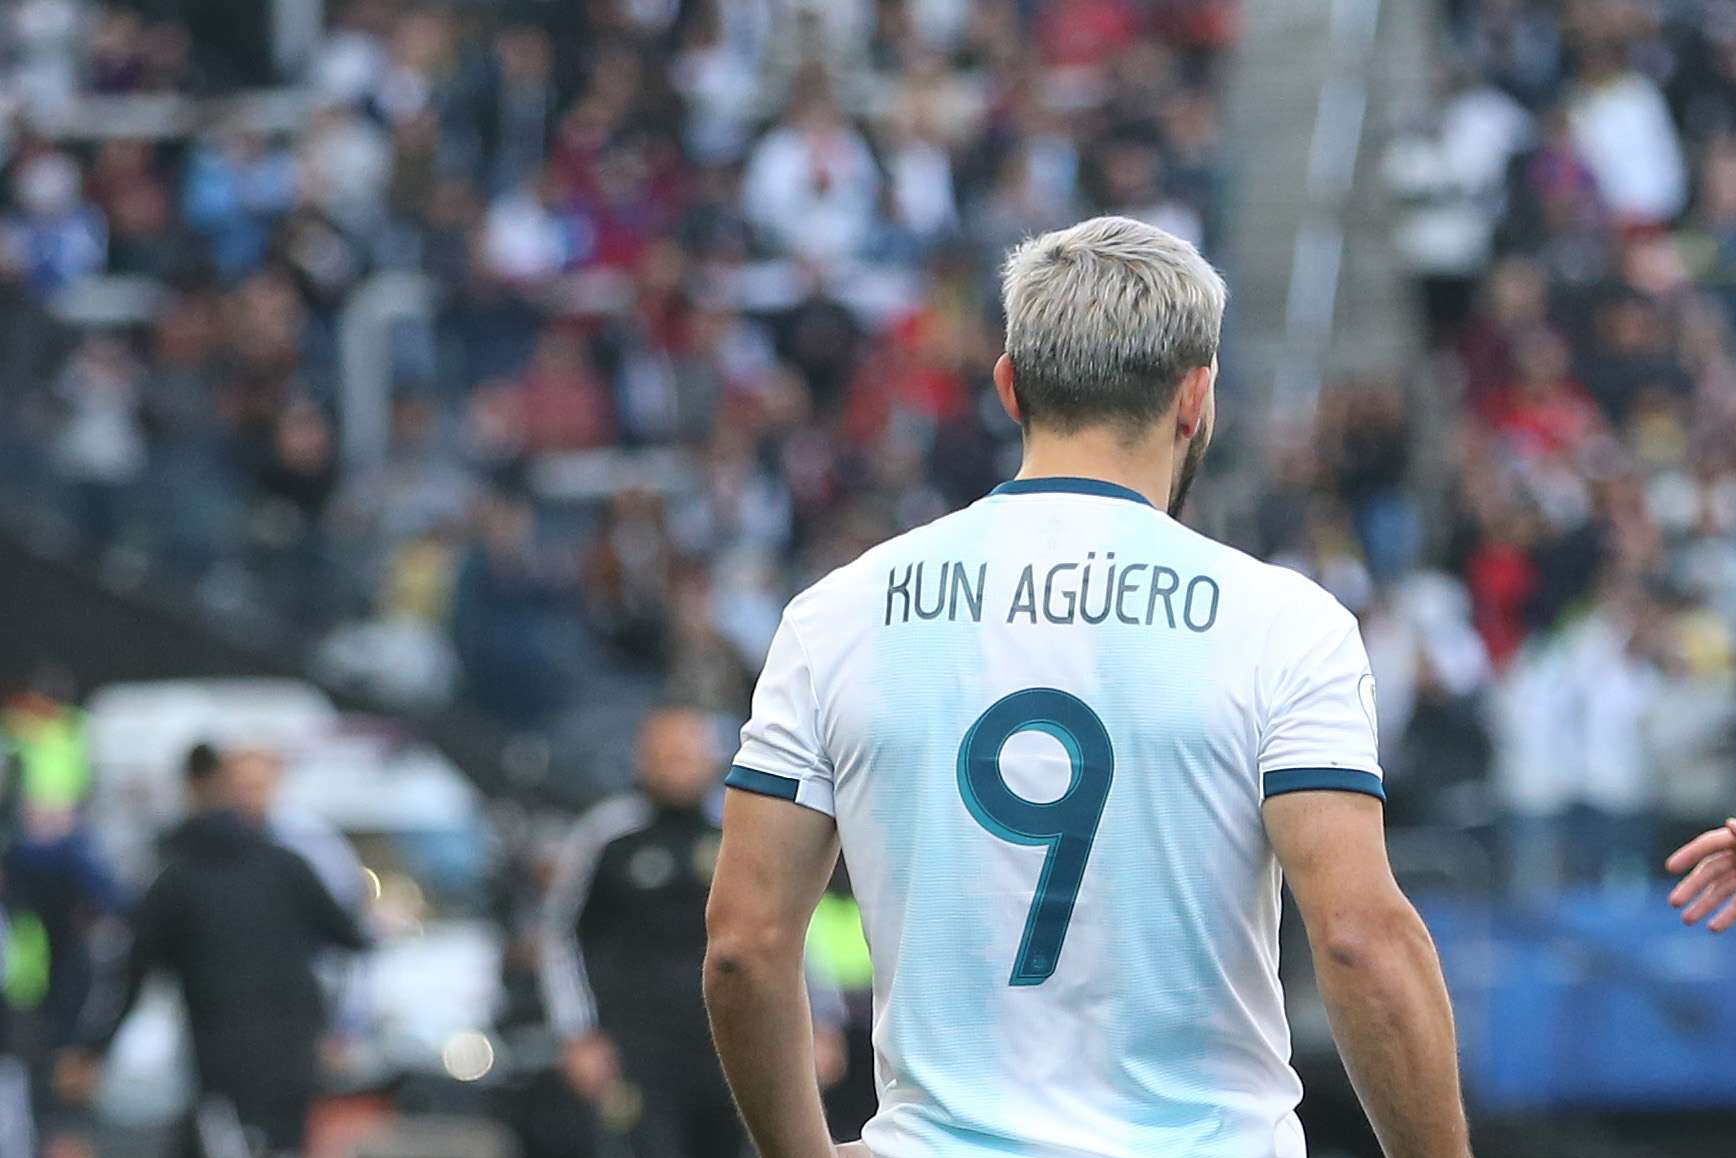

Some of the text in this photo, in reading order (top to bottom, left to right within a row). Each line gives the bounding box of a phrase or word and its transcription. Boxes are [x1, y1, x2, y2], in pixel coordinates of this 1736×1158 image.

[885, 551, 1220, 632] KUN AGÜERO
[956, 687, 1115, 986] 9
